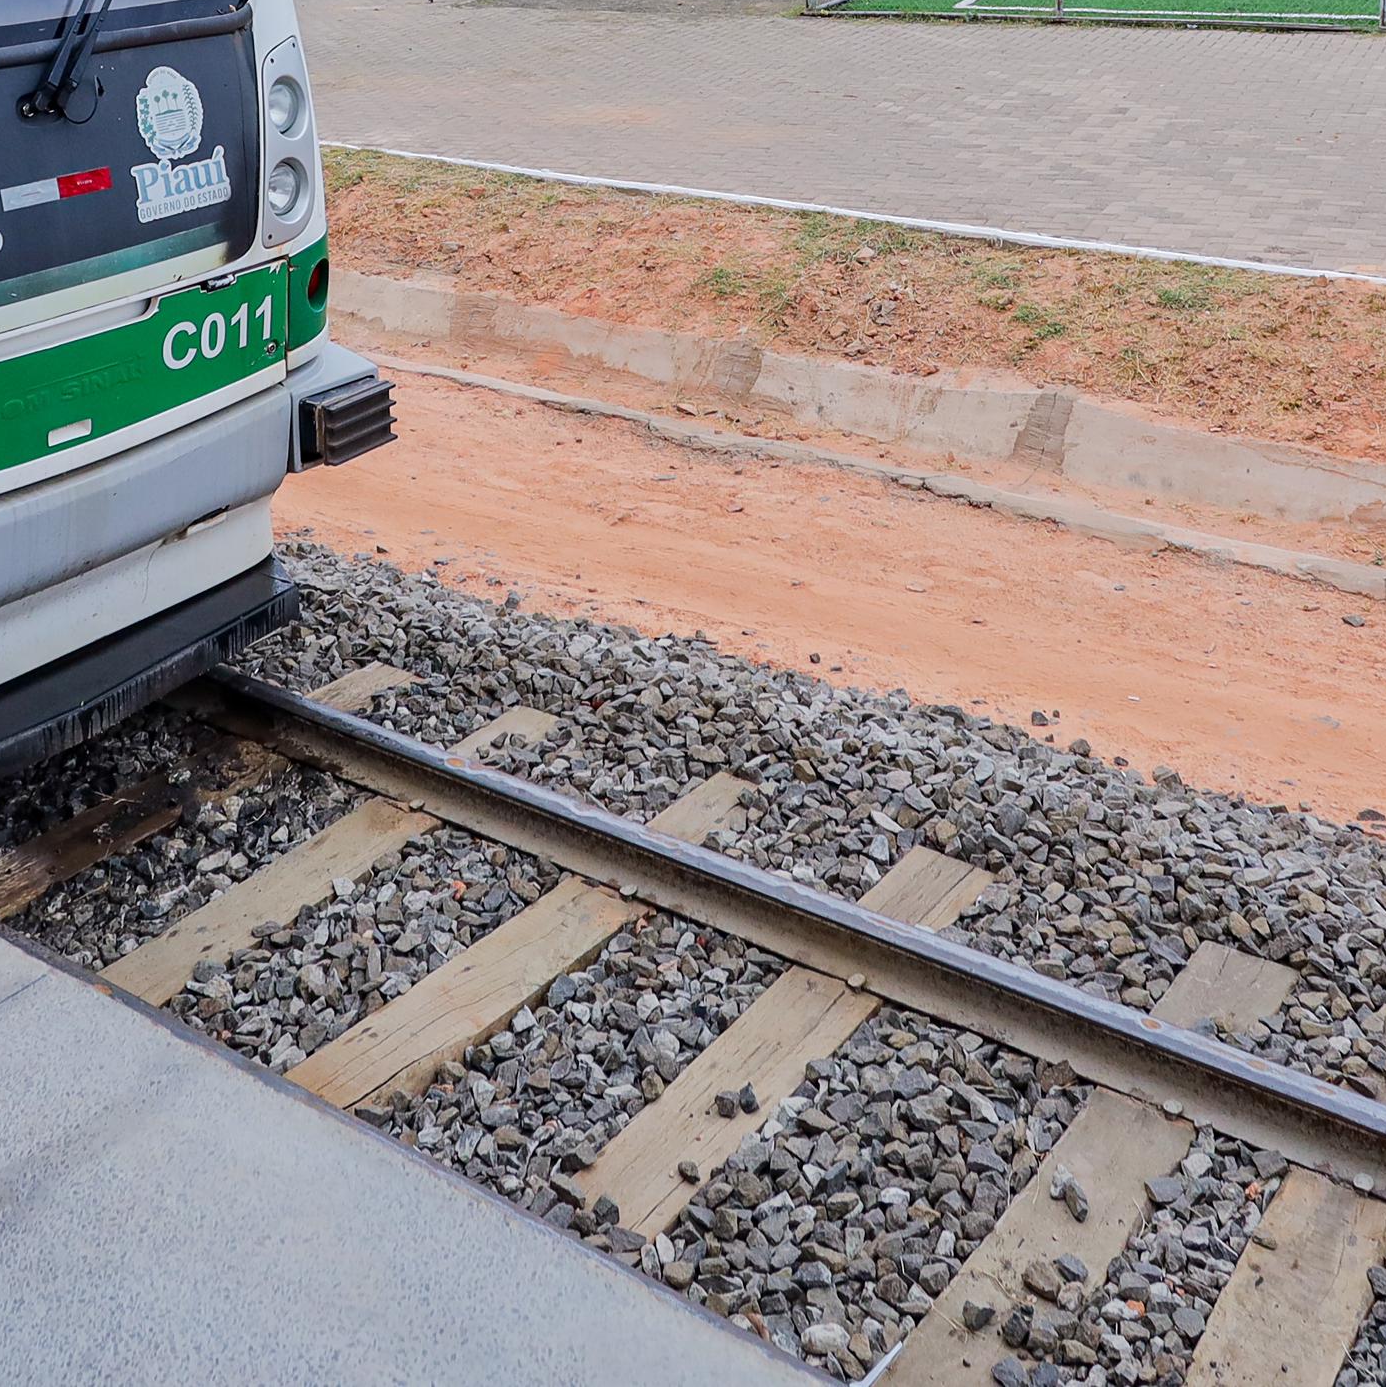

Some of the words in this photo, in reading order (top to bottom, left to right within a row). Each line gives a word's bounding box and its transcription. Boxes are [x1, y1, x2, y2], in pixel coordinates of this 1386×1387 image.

[134, 149, 226, 203] Piauí
[140, 201, 181, 220] GOVERNO
[184, 196, 196, 208] DO
[198, 187, 229, 204] ESTADO
[162, 294, 273, 371] C011
